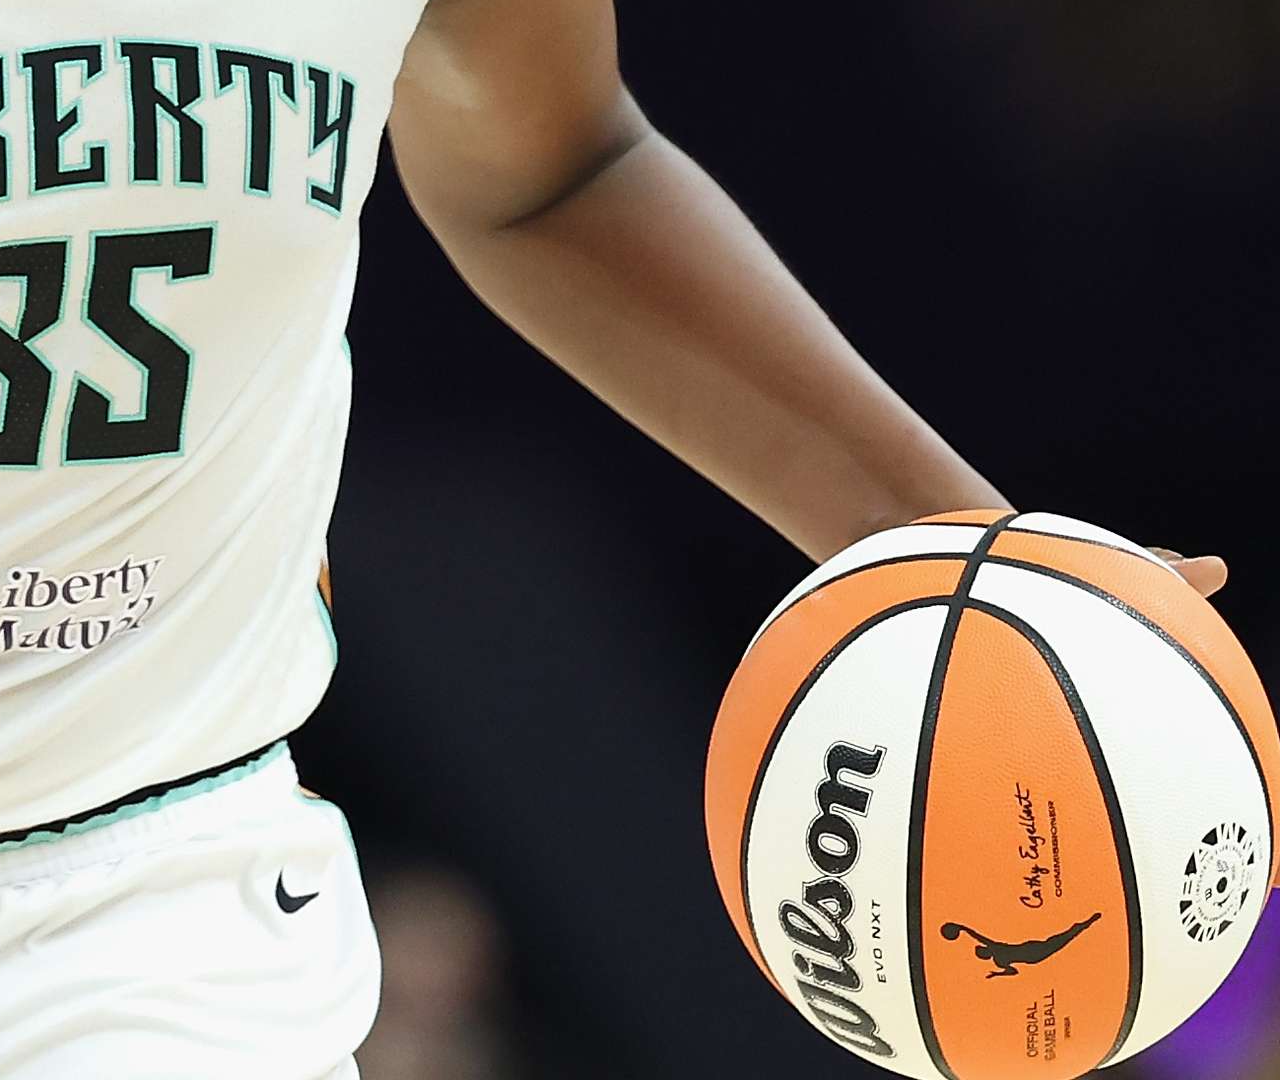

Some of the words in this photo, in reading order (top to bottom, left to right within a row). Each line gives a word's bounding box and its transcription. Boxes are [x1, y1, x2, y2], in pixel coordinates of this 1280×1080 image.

[1048, 800, 1063, 898] COMMISSIONER
[778, 741, 897, 1058] Wilson
[871, 899, 881, 939] NXT
[873, 948, 887, 983] EVO
[1026, 1001, 1039, 1058] OFFICIAL
[1043, 988, 1055, 1027] BALL
